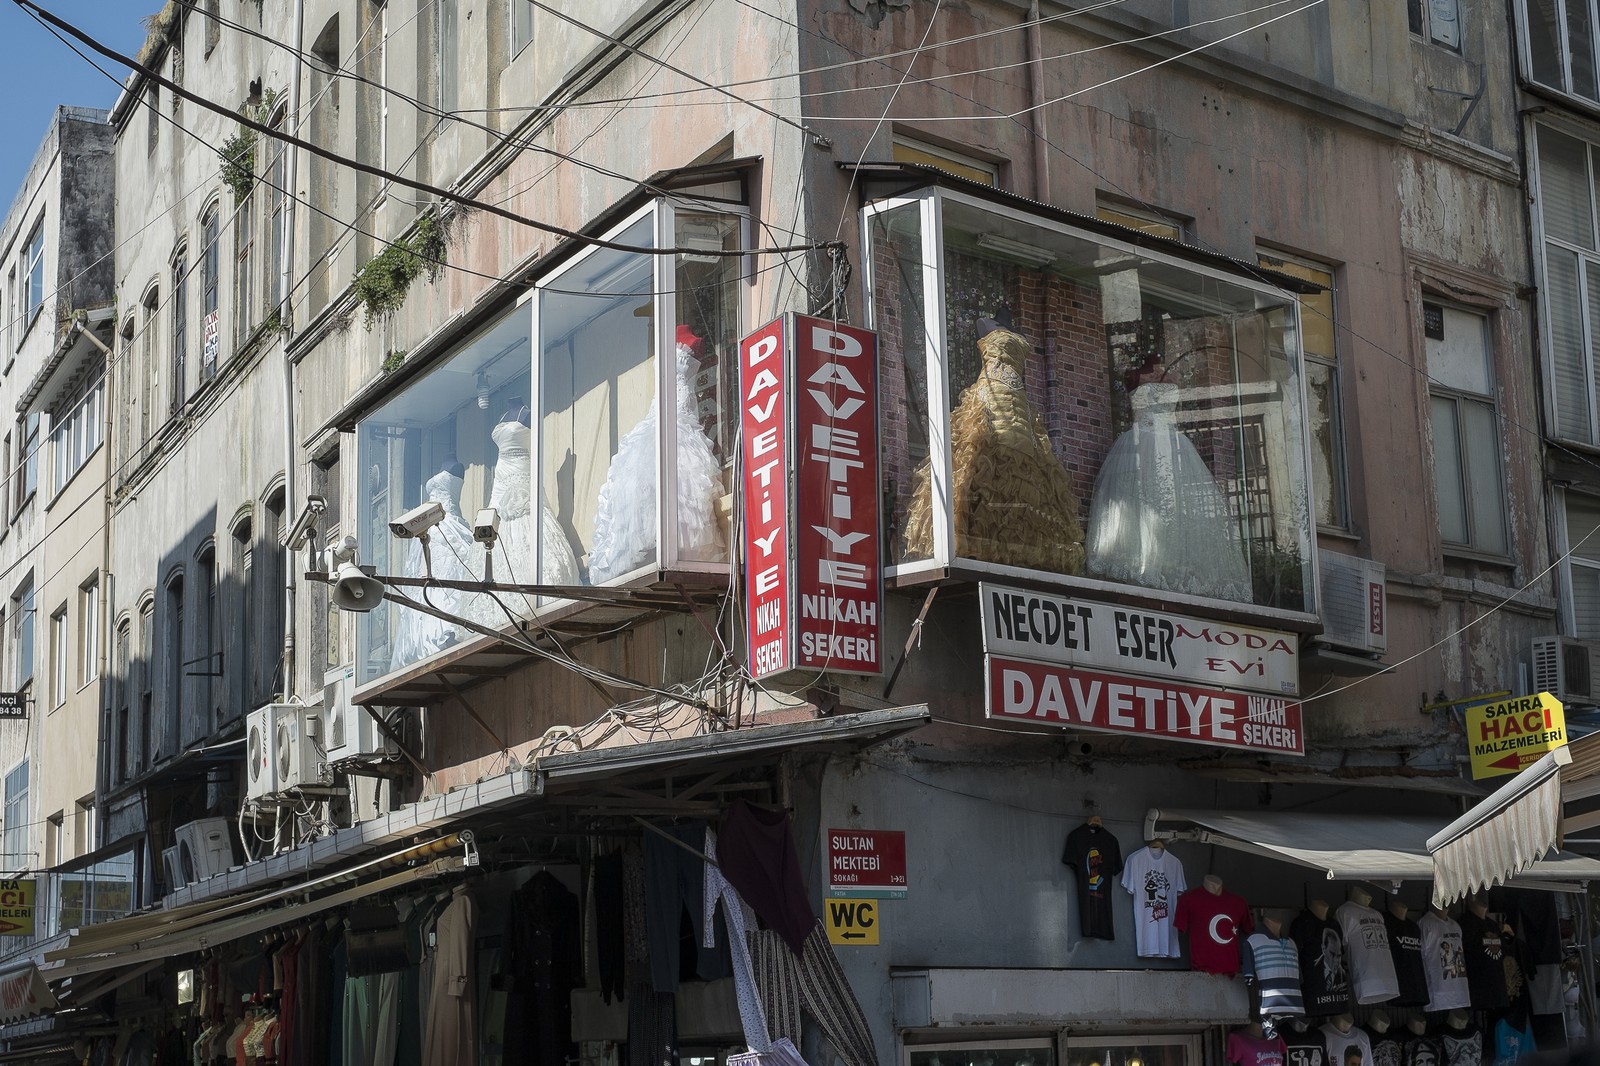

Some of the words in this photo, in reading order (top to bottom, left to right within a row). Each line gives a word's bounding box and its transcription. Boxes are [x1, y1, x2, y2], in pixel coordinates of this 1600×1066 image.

[747, 334, 780, 597] DAVETİYE
[807, 326, 870, 590] DAVETİYE
[756, 597, 780, 636] NİKAH
[802, 589, 876, 626] NİKAH
[992, 592, 1093, 652] NECDET
[1114, 611, 1177, 670] ESER
[1176, 623, 1295, 655] MODA
[756, 631, 783, 677] ŞEKERİ
[801, 631, 876, 663] ŞEKERİ
[1204, 657, 1265, 676] EVİ
[1003, 668, 1237, 741] DAVETİYE
[1248, 695, 1286, 726] NİKAH
[1485, 697, 1543, 719] SAHRA
[1242, 723, 1297, 749] ŞEKERİ
[1480, 708, 1552, 741] HACI
[1475, 727, 1562, 756] MALZEMELERİ
[832, 836, 874, 851] SULTAN
[833, 854, 880, 871] MEKTEBİ
[833, 874, 858, 882] SOKAĞI
[1, 880, 19, 890] RA
[830, 903, 874, 928] WC
